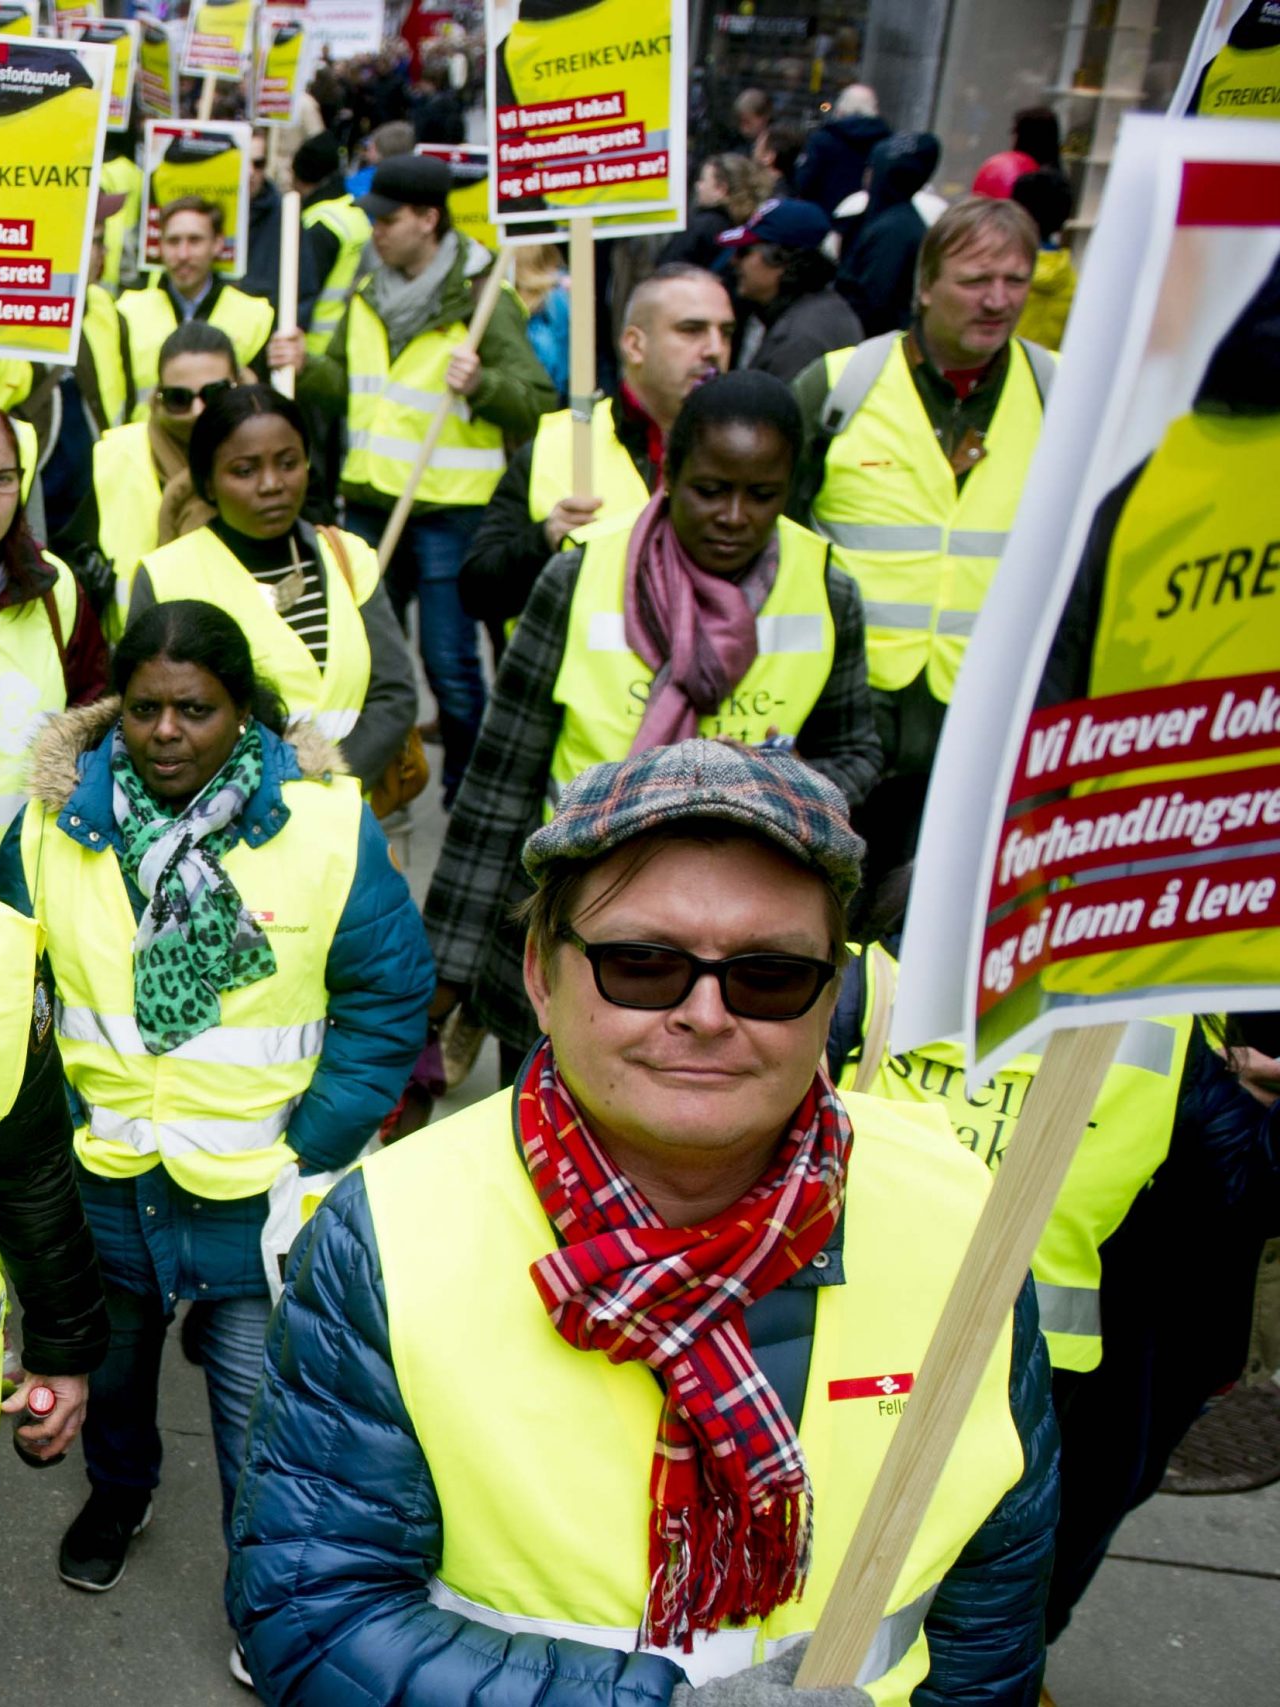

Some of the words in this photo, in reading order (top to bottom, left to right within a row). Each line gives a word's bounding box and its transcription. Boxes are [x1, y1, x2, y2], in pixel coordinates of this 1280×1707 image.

[533, 35, 672, 80] STREIKEVAKT
[499, 111, 517, 130] Vi
[520, 106, 573, 127] krever
[575, 96, 622, 121] lokal
[1214, 86, 1280, 108] STREIKEV
[500, 127, 641, 162] forhandlingsrett
[500, 179, 522, 198] og
[524, 173, 540, 191] ei
[542, 169, 581, 189] lønn
[584, 165, 596, 183] å
[598, 161, 635, 181] leve
[638, 156, 666, 176] av!
[38, 302, 70, 322] av!
[1025, 718, 1071, 779] Vi
[1067, 705, 1208, 766] krever
[1210, 685, 1280, 742] lok
[999, 787, 1280, 886] forhandlingsre
[983, 936, 1019, 993] og
[1020, 907, 1052, 964] ei
[1050, 897, 1145, 948] lønn
[1149, 878, 1182, 929] å
[1185, 877, 1276, 923] leve
